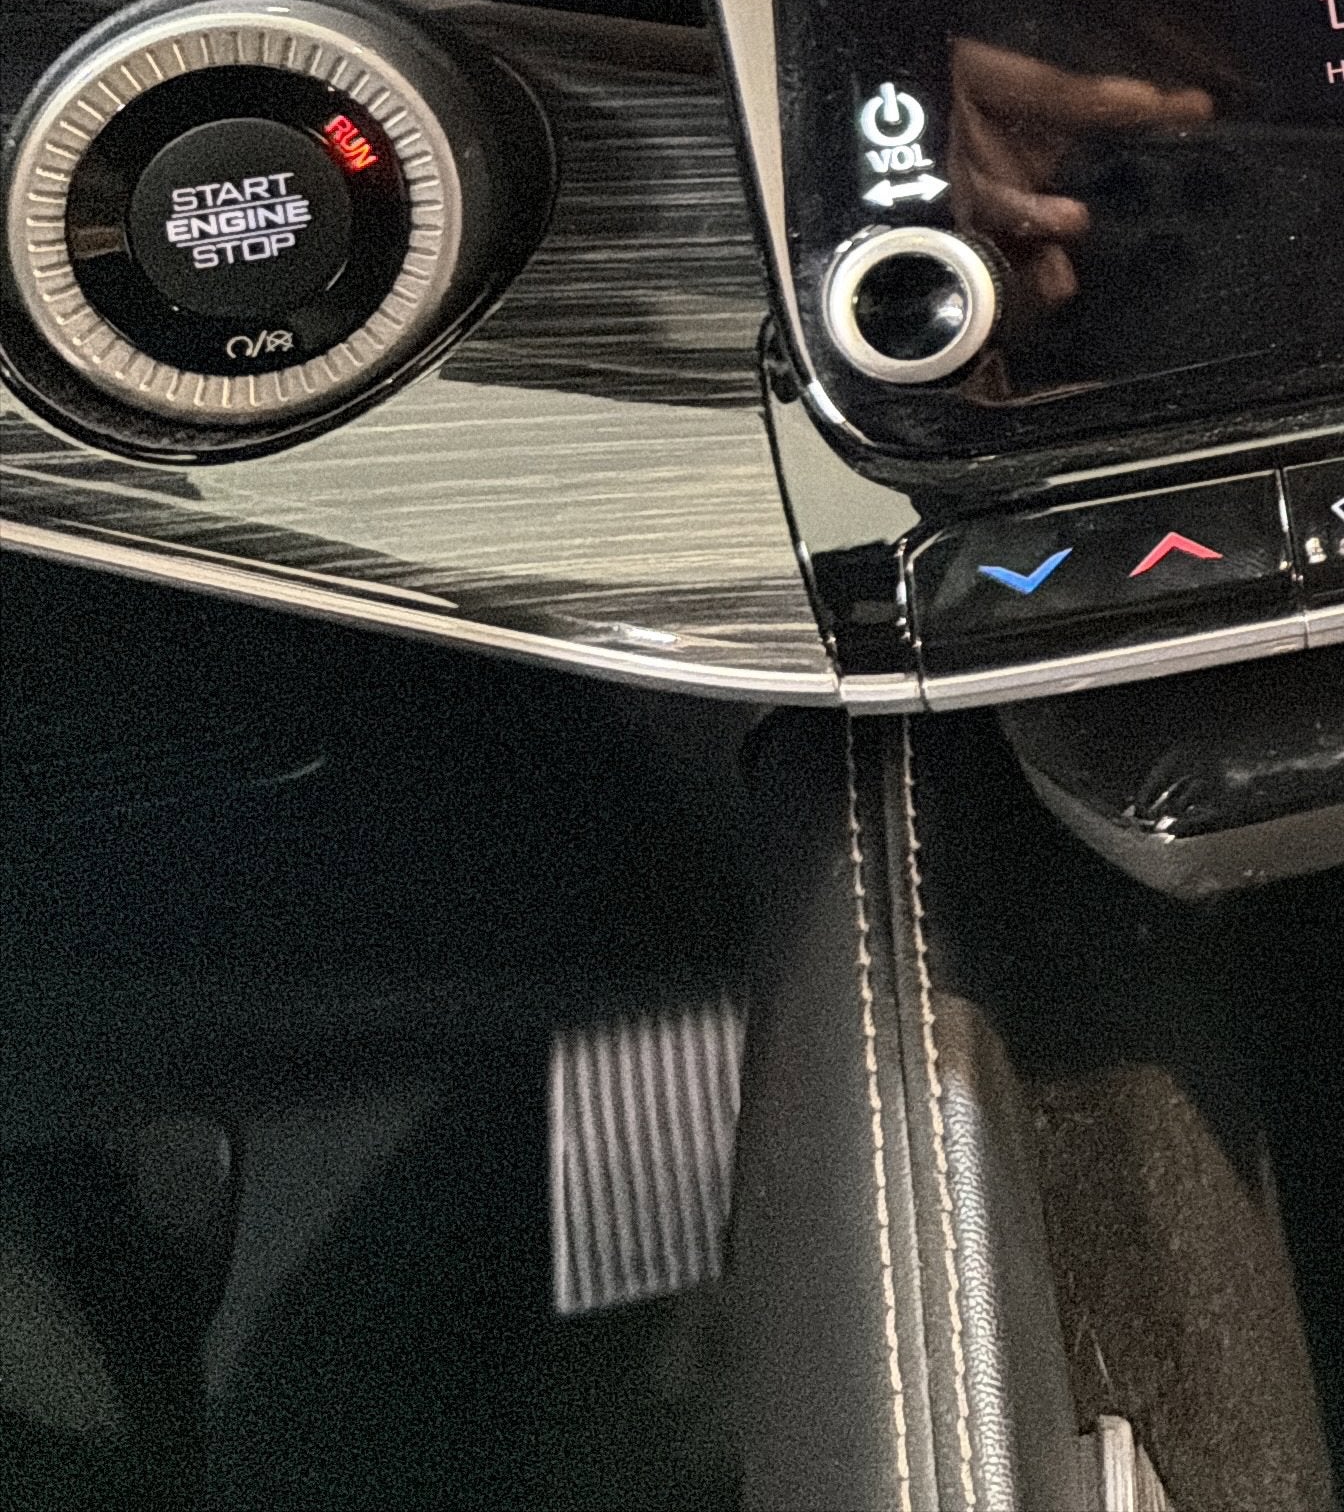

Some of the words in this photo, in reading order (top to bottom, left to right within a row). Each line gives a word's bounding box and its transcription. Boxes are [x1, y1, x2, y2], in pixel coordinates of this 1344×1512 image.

[325, 115, 378, 171] RUN
[865, 143, 934, 173] VOL
[171, 172, 294, 212] START
[165, 199, 312, 242] ENGINE
[192, 232, 296, 269] STOP
